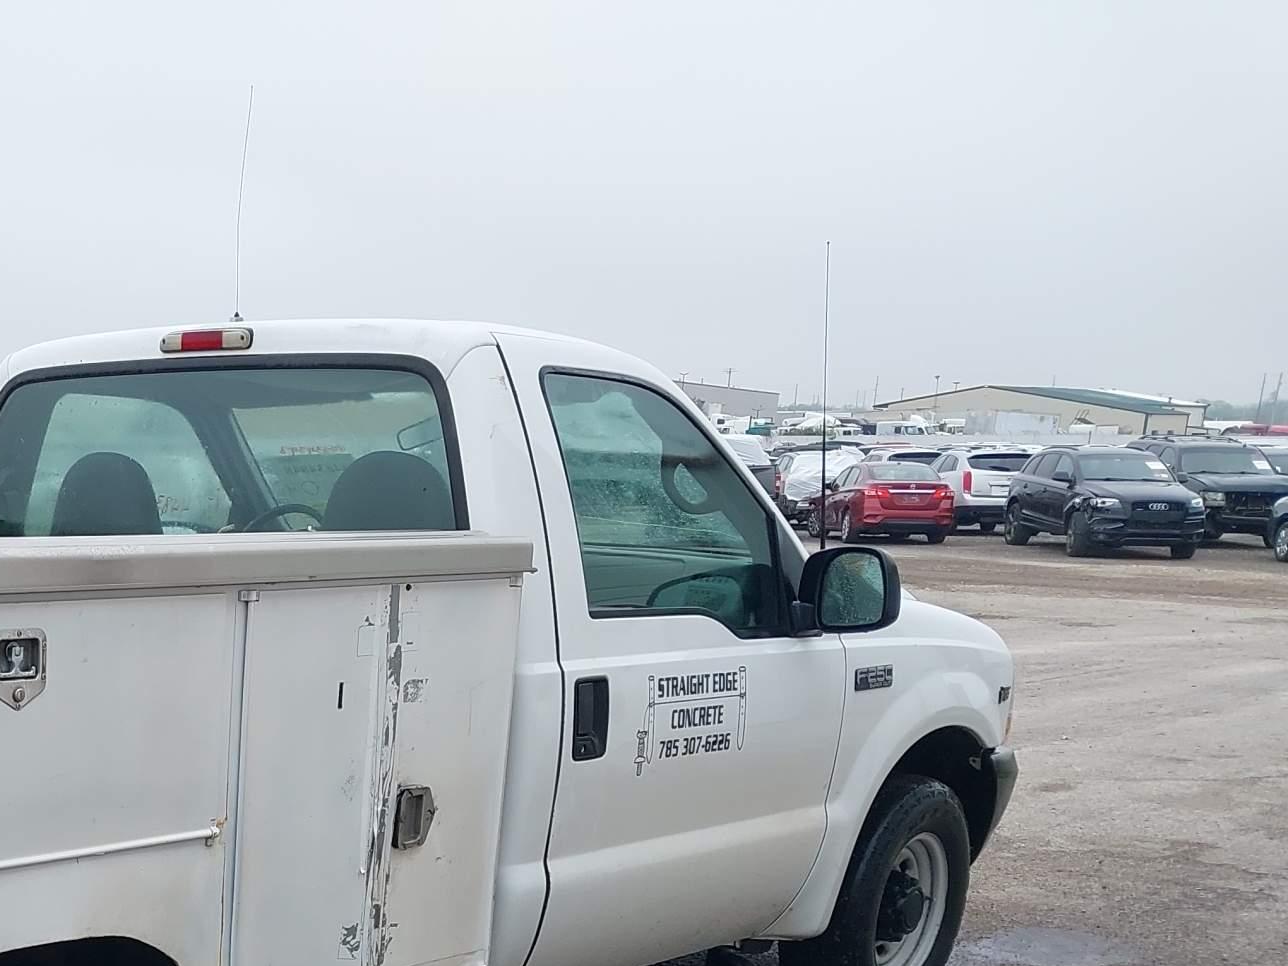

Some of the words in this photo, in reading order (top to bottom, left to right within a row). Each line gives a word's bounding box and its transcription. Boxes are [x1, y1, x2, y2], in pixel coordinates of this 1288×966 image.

[658, 674, 710, 698] STRAIGHT
[713, 672, 737, 692] EDGE
[671, 705, 724, 729] CONCRETE
[659, 739, 680, 759] 785
[682, 733, 731, 756] 307-6226
